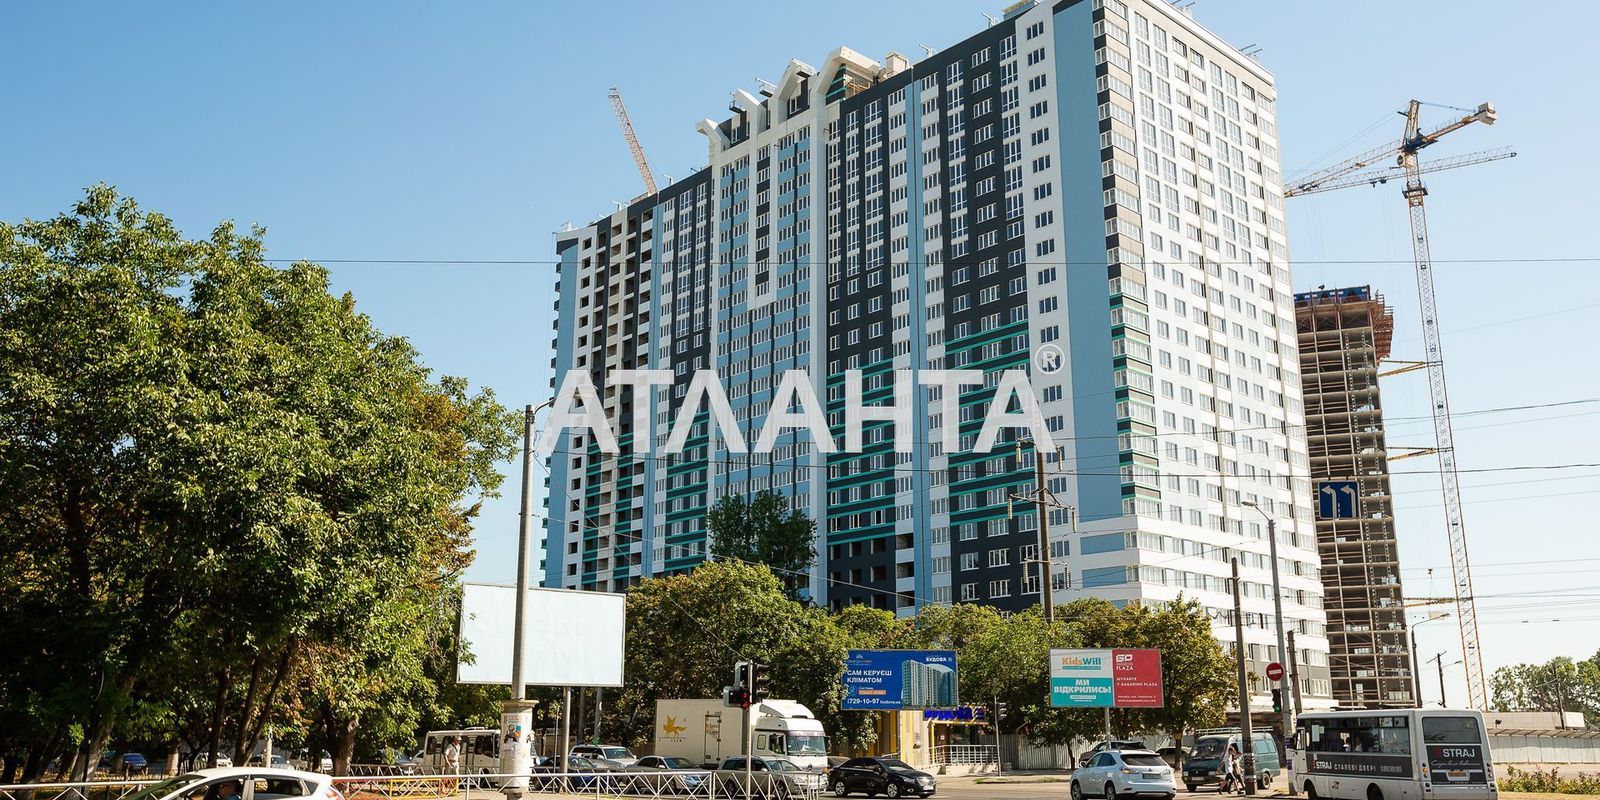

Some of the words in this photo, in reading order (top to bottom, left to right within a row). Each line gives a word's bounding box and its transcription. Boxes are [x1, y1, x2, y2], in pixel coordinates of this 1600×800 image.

[1062, 657, 1101, 665] KidsWill
[1054, 686, 1111, 694] ВІДКРИЛИСЬ!
[1443, 748, 1475, 758] STRAJ
[1315, 761, 1332, 769] STRAJ
